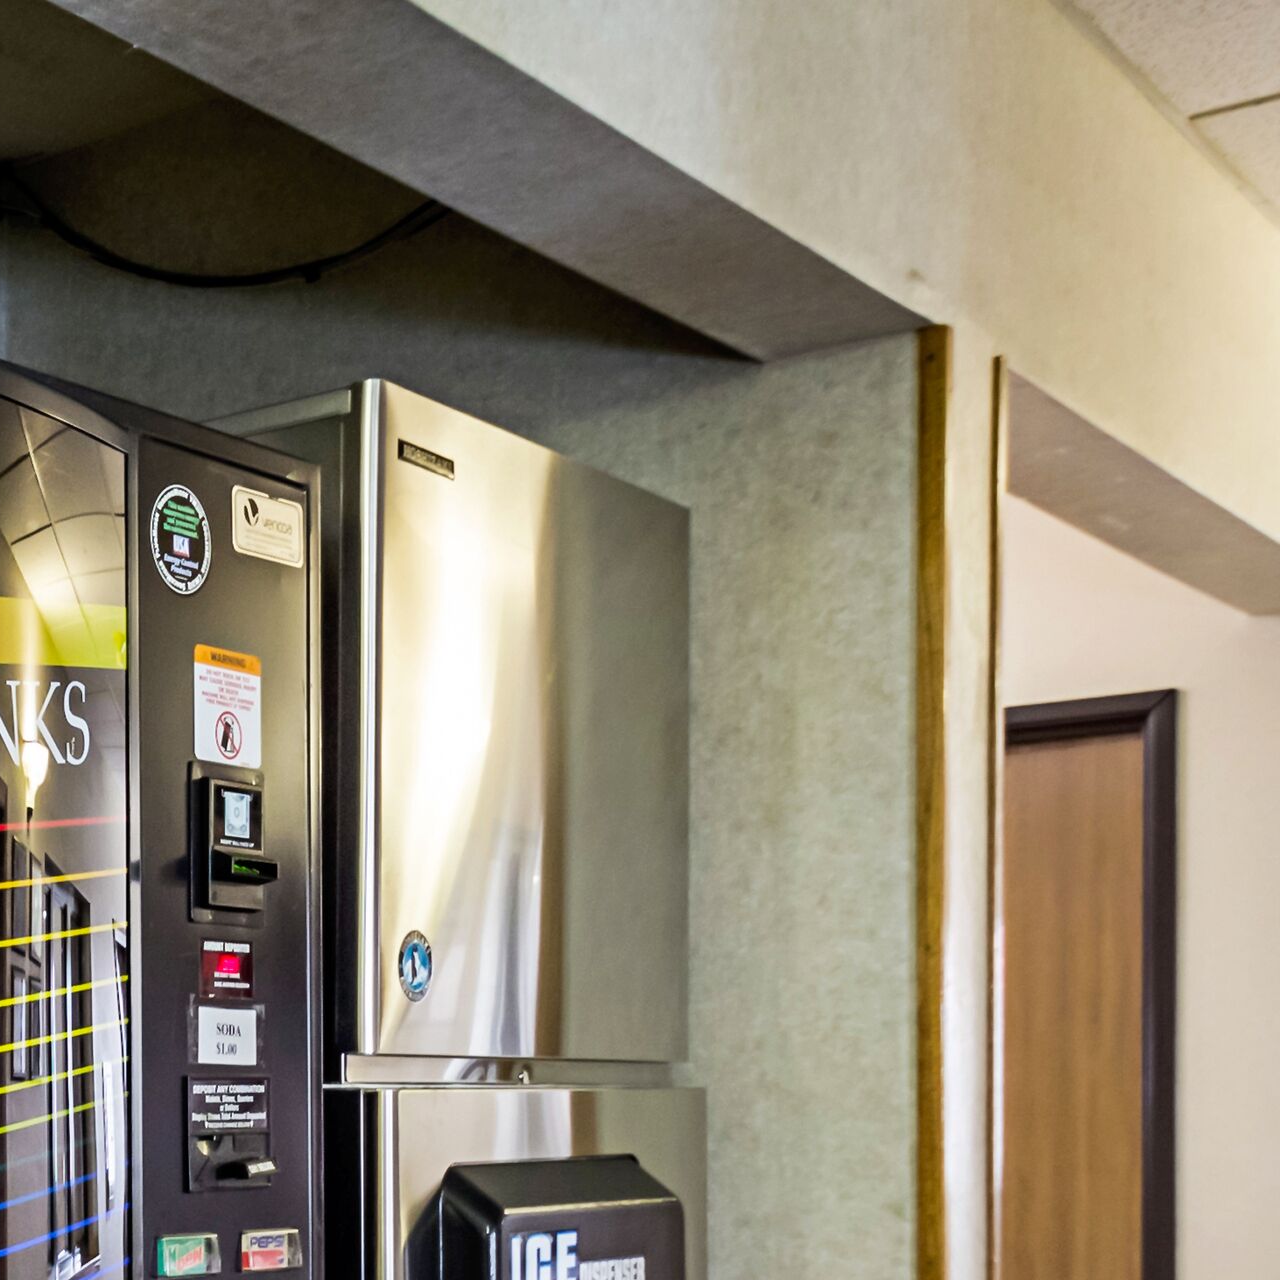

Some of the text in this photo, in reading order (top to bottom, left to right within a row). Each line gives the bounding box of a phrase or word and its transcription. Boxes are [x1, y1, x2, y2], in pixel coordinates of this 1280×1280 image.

[216, 1023, 242, 1037] SODA
[216, 1042, 237, 1056] $1.00
[250, 1235, 285, 1248] PEPSI
